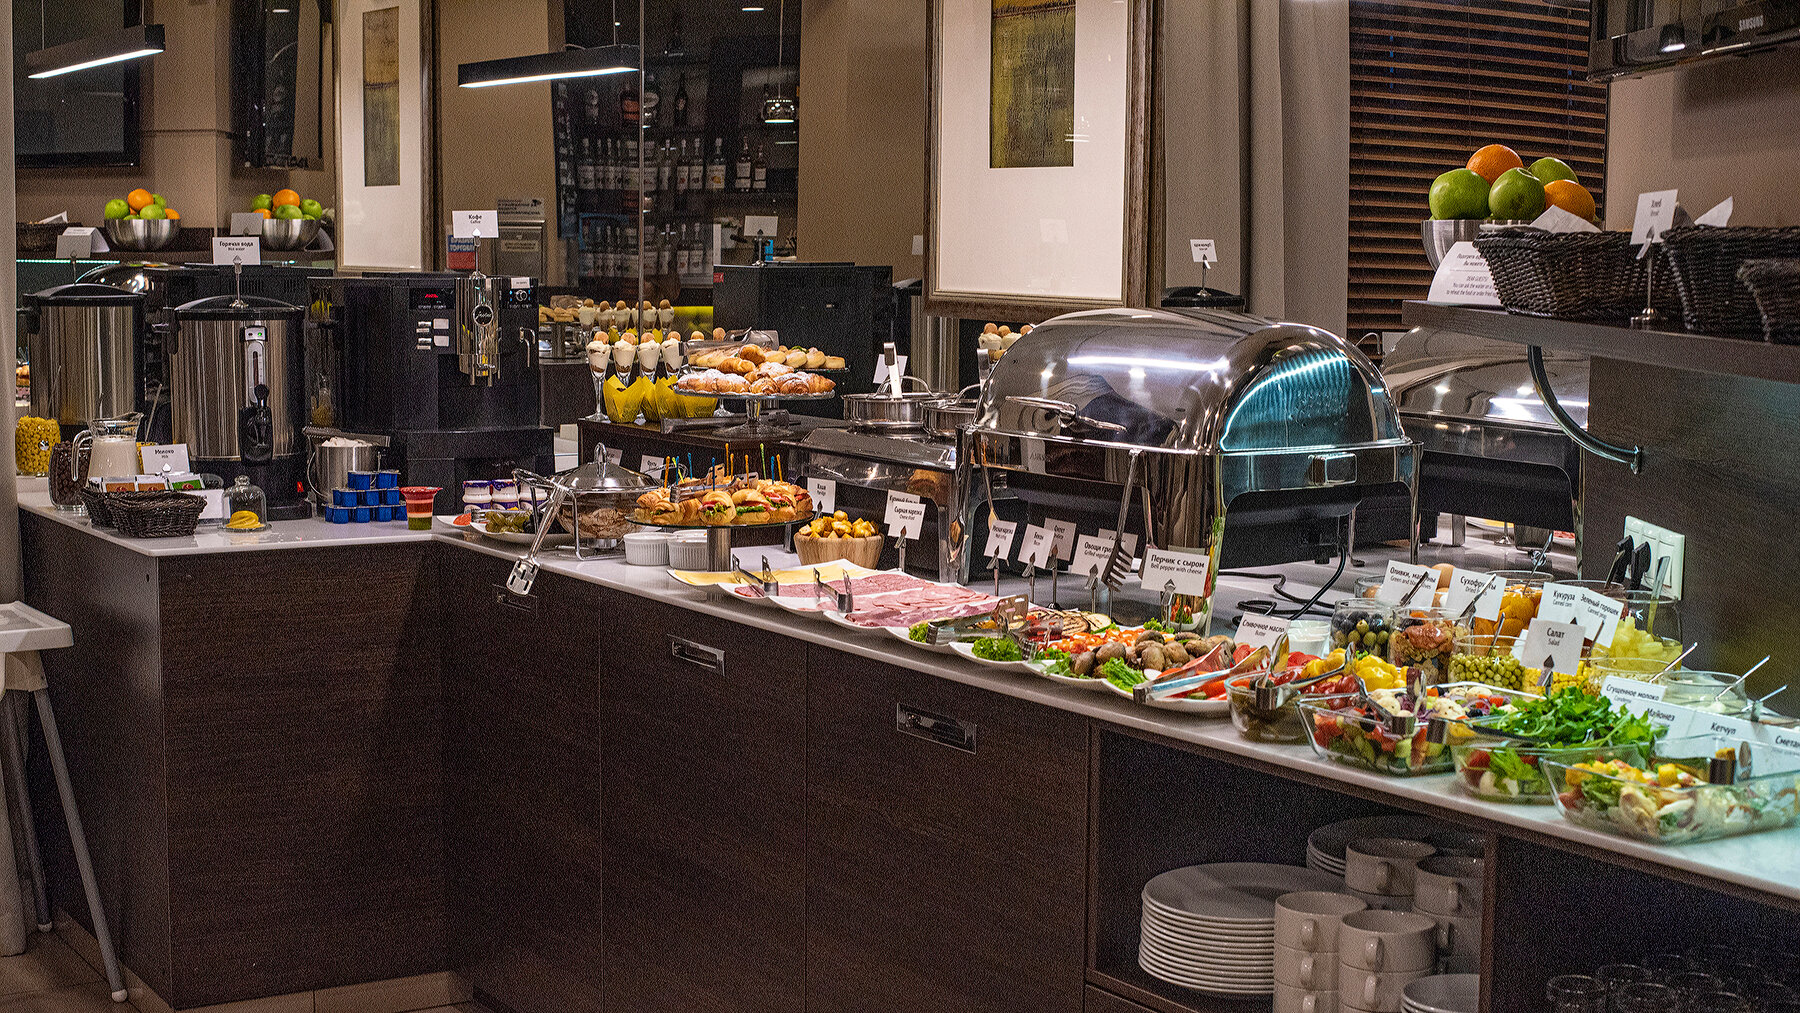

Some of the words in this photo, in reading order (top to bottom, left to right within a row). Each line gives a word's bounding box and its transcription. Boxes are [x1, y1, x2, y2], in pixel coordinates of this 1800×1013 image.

[1739, 15, 1763, 31] SAMSUNG
[1084, 541, 1101, 552] Овощи
[1151, 554, 1176, 566] Перчик
[1182, 560, 1204, 569] сыром
[1159, 565, 1176, 573] pepper
[1391, 574, 1402, 583] Green
[1553, 590, 1576, 601] Кукуруза
[1600, 603, 1620, 616] горошек
[1242, 619, 1269, 630] Сливочное
[1546, 627, 1565, 639] Салат
[1606, 683, 1638, 698] Сгущенное
[1637, 691, 1660, 701] молоко
[1647, 707, 1676, 722] Майонез
[1710, 721, 1737, 736] Кетчуп
